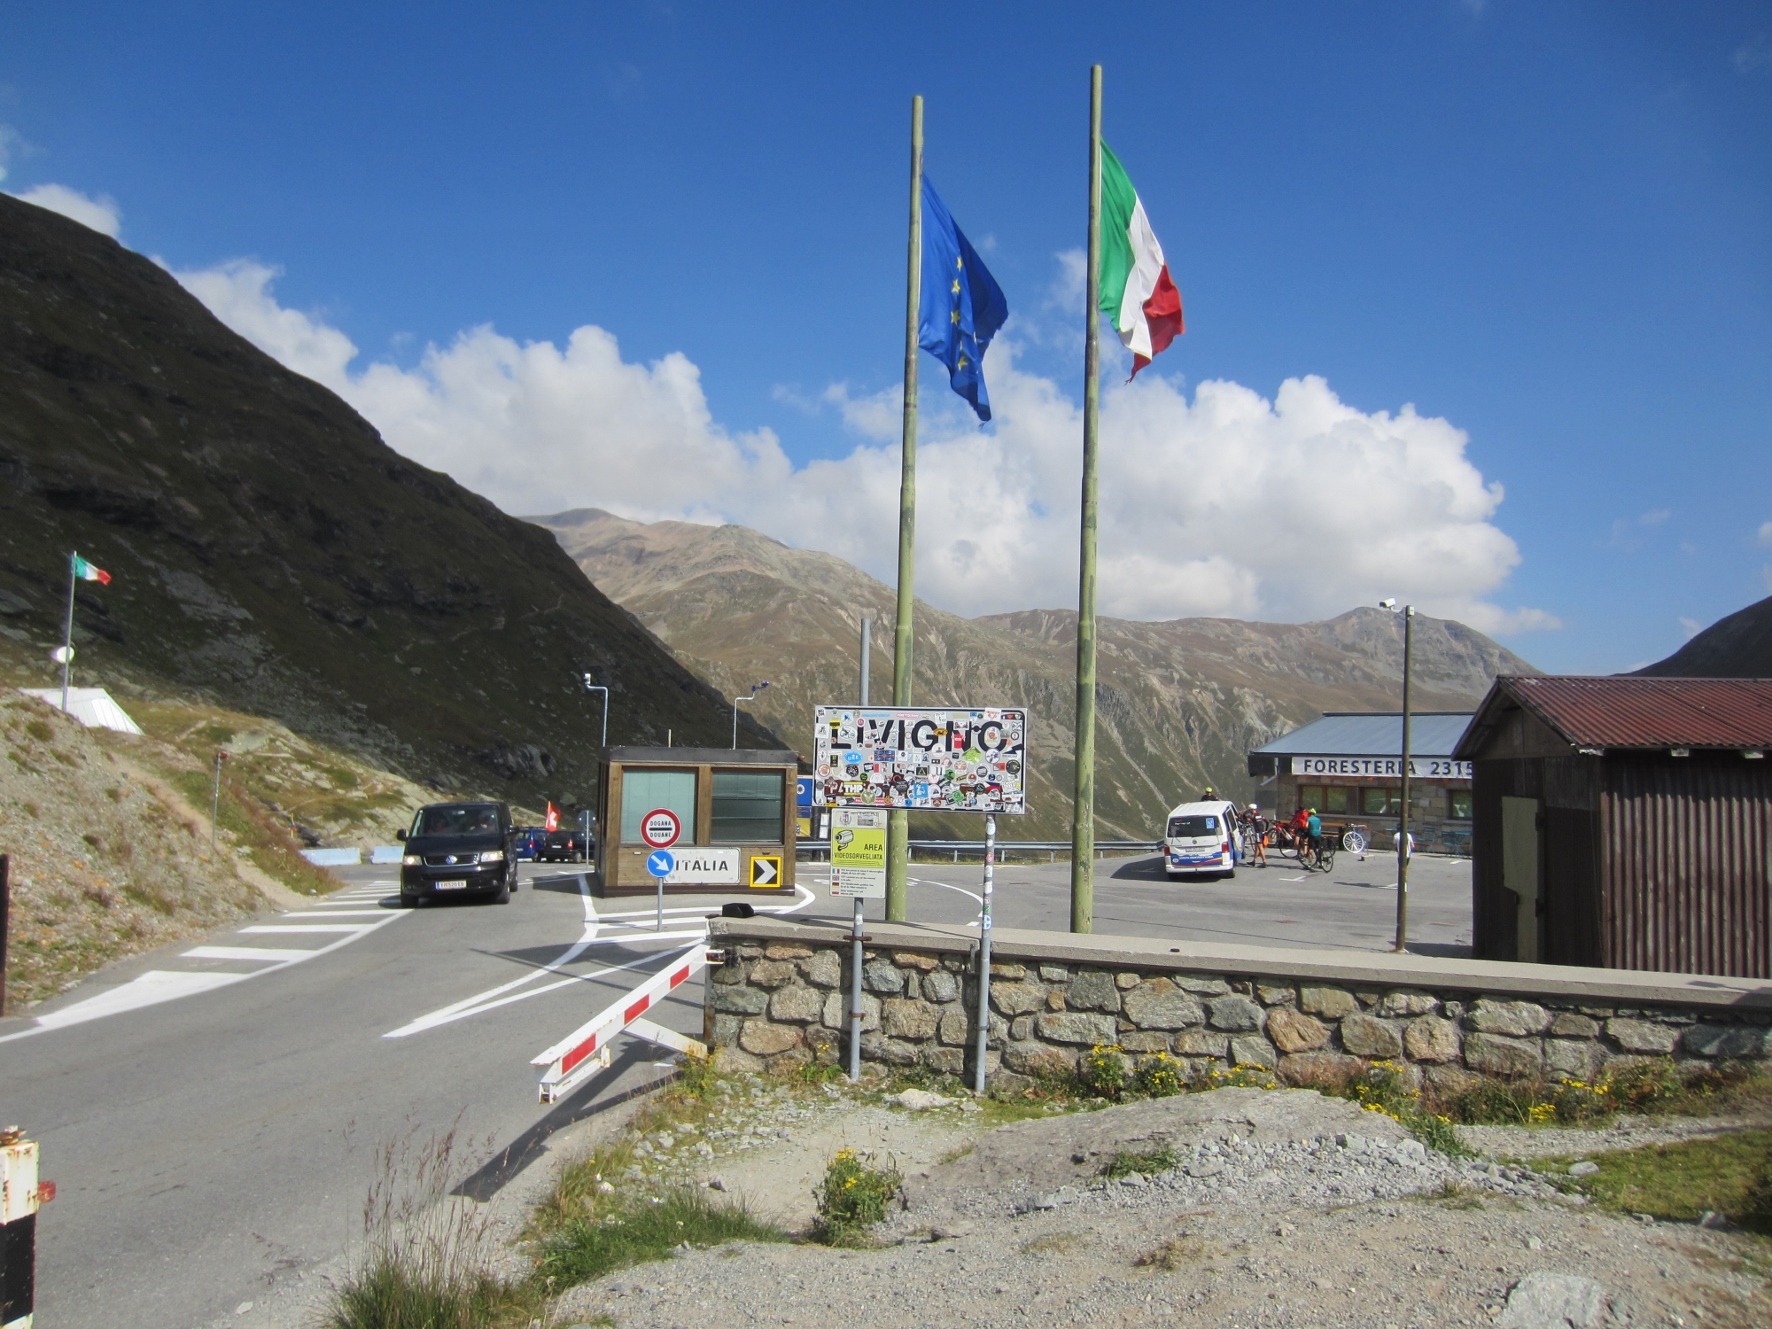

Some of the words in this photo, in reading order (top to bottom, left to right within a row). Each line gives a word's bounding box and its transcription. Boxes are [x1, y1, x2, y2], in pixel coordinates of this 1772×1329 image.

[831, 719, 1007, 752] LIVIGNO
[1304, 759, 1416, 775] FORESTERIA
[864, 843, 883, 851] AREA
[834, 852, 883, 861] VIDEOSORVEGLIATA
[675, 860, 729, 871] ITALIA
